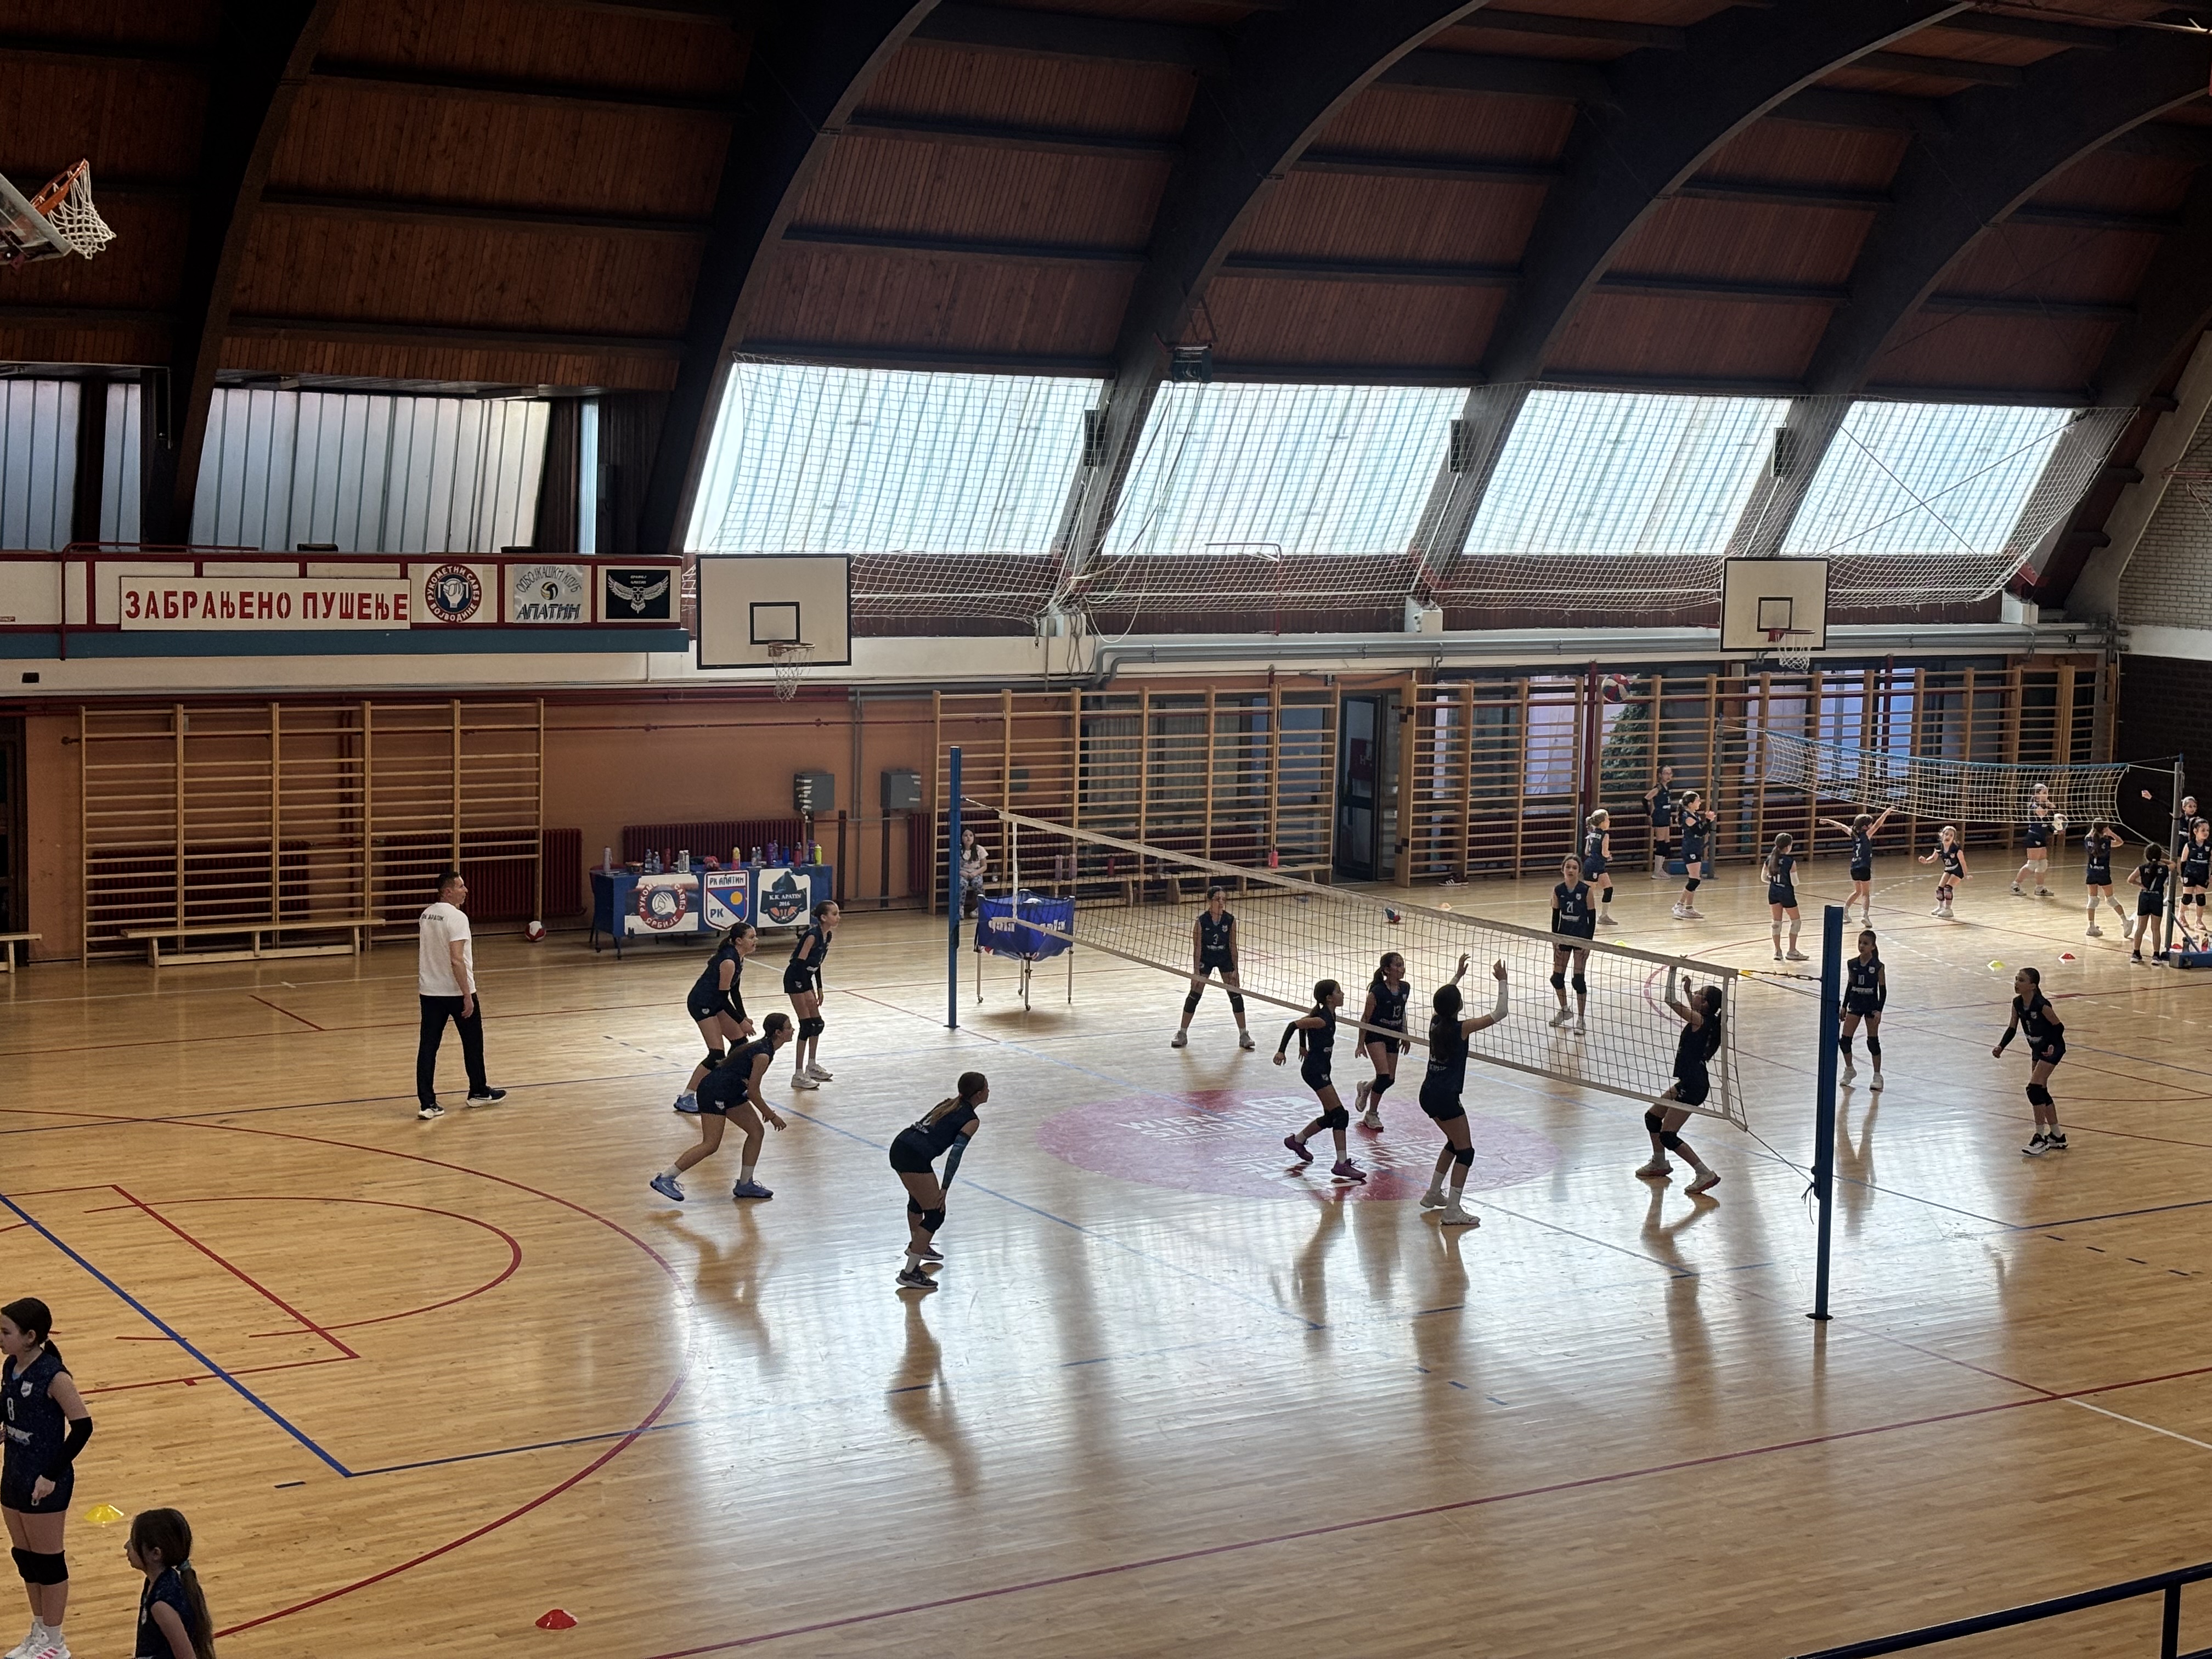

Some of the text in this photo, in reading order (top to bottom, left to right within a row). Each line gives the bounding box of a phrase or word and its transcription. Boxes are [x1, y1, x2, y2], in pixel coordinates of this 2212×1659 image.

[427, 566, 480, 601] РУКОМЕТНИ САВЕЗ
[561, 572, 582, 592] КЛУБ
[125, 590, 408, 620] ЗАБРАЊЕНО ПУШЕЊЕ
[430, 603, 477, 623] ВОЈВОДИНЕ
[516, 603, 581, 620] АПАТИН
[710, 908, 724, 918] РК
[1566, 901, 1573, 913] 21
[1212, 933, 1218, 945] 3
[1858, 974, 1865, 985] 10
[1392, 1005, 1401, 1018] 13
[1115, 1110, 1267, 1130] WIENER
[1141, 1113, 1322, 1138] STÄDTISC
[7, 1397, 15, 1421] 8
